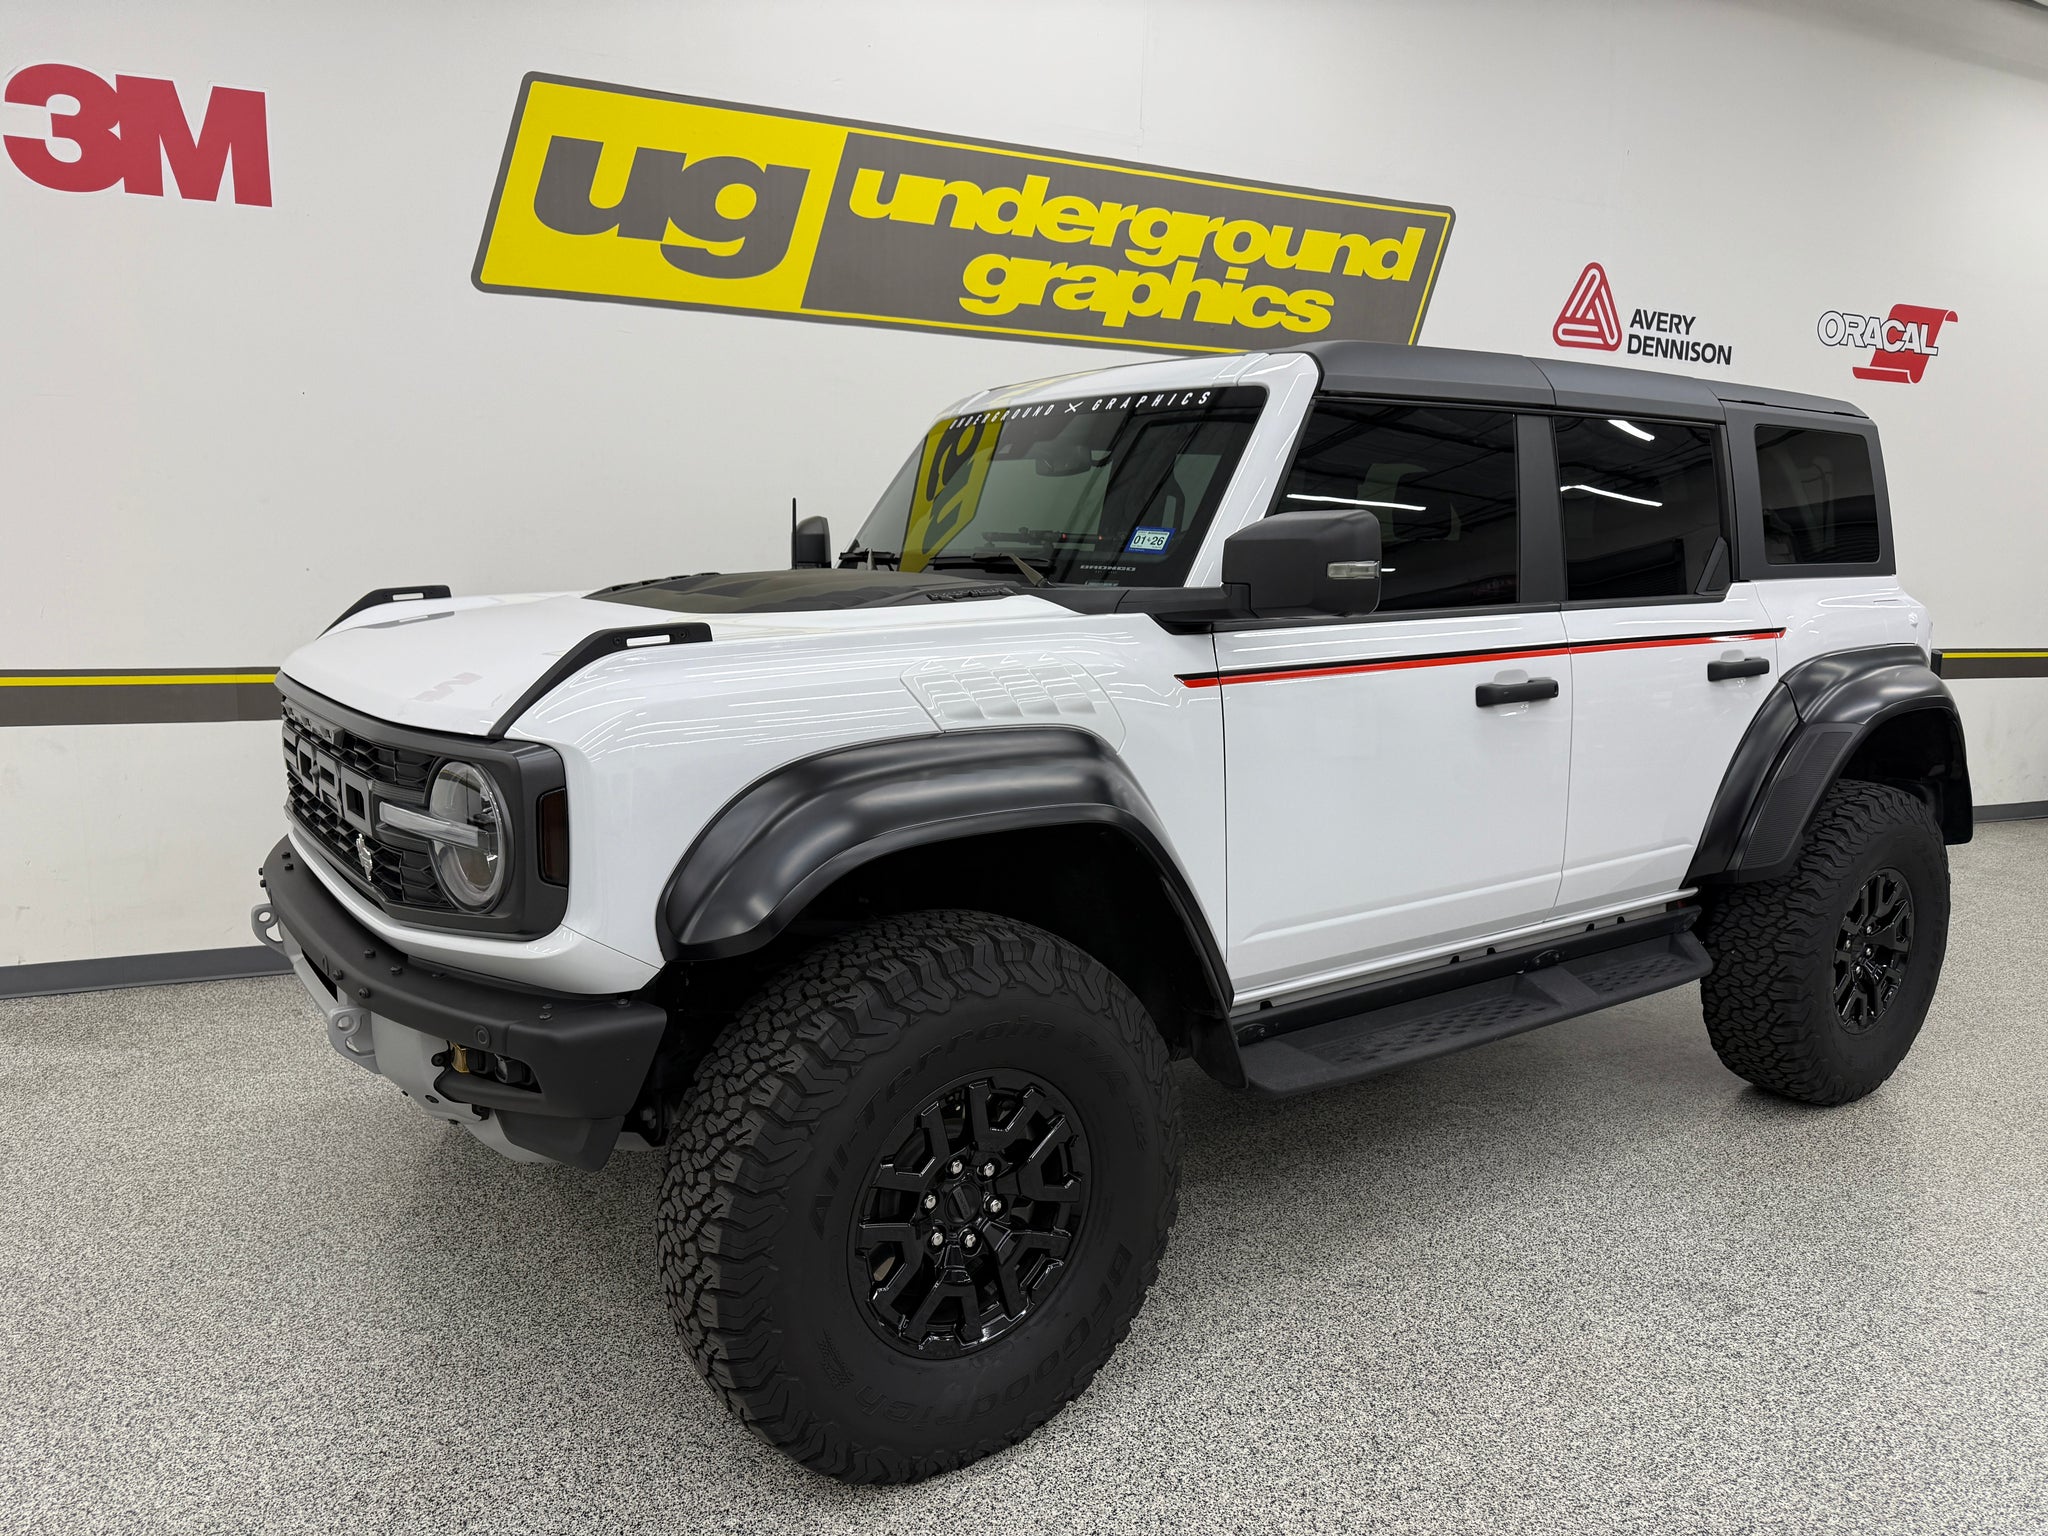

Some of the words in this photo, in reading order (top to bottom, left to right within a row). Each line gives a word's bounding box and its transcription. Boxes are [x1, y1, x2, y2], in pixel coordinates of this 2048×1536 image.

[3, 63, 273, 208] 3M
[533, 134, 811, 281] ug
[848, 167, 1426, 281] underground
[959, 252, 1335, 333] graphics
[1630, 309, 1696, 335] AVERY
[1817, 310, 1939, 356] ORACAL
[1627, 333, 1732, 365] DENNISON
[949, 403, 1056, 431] UNDERGROUND
[1091, 391, 1212, 412] GRAPHICS
[1150, 536, 1165, 546] 26
[1080, 564, 1136, 572] BRONCO
